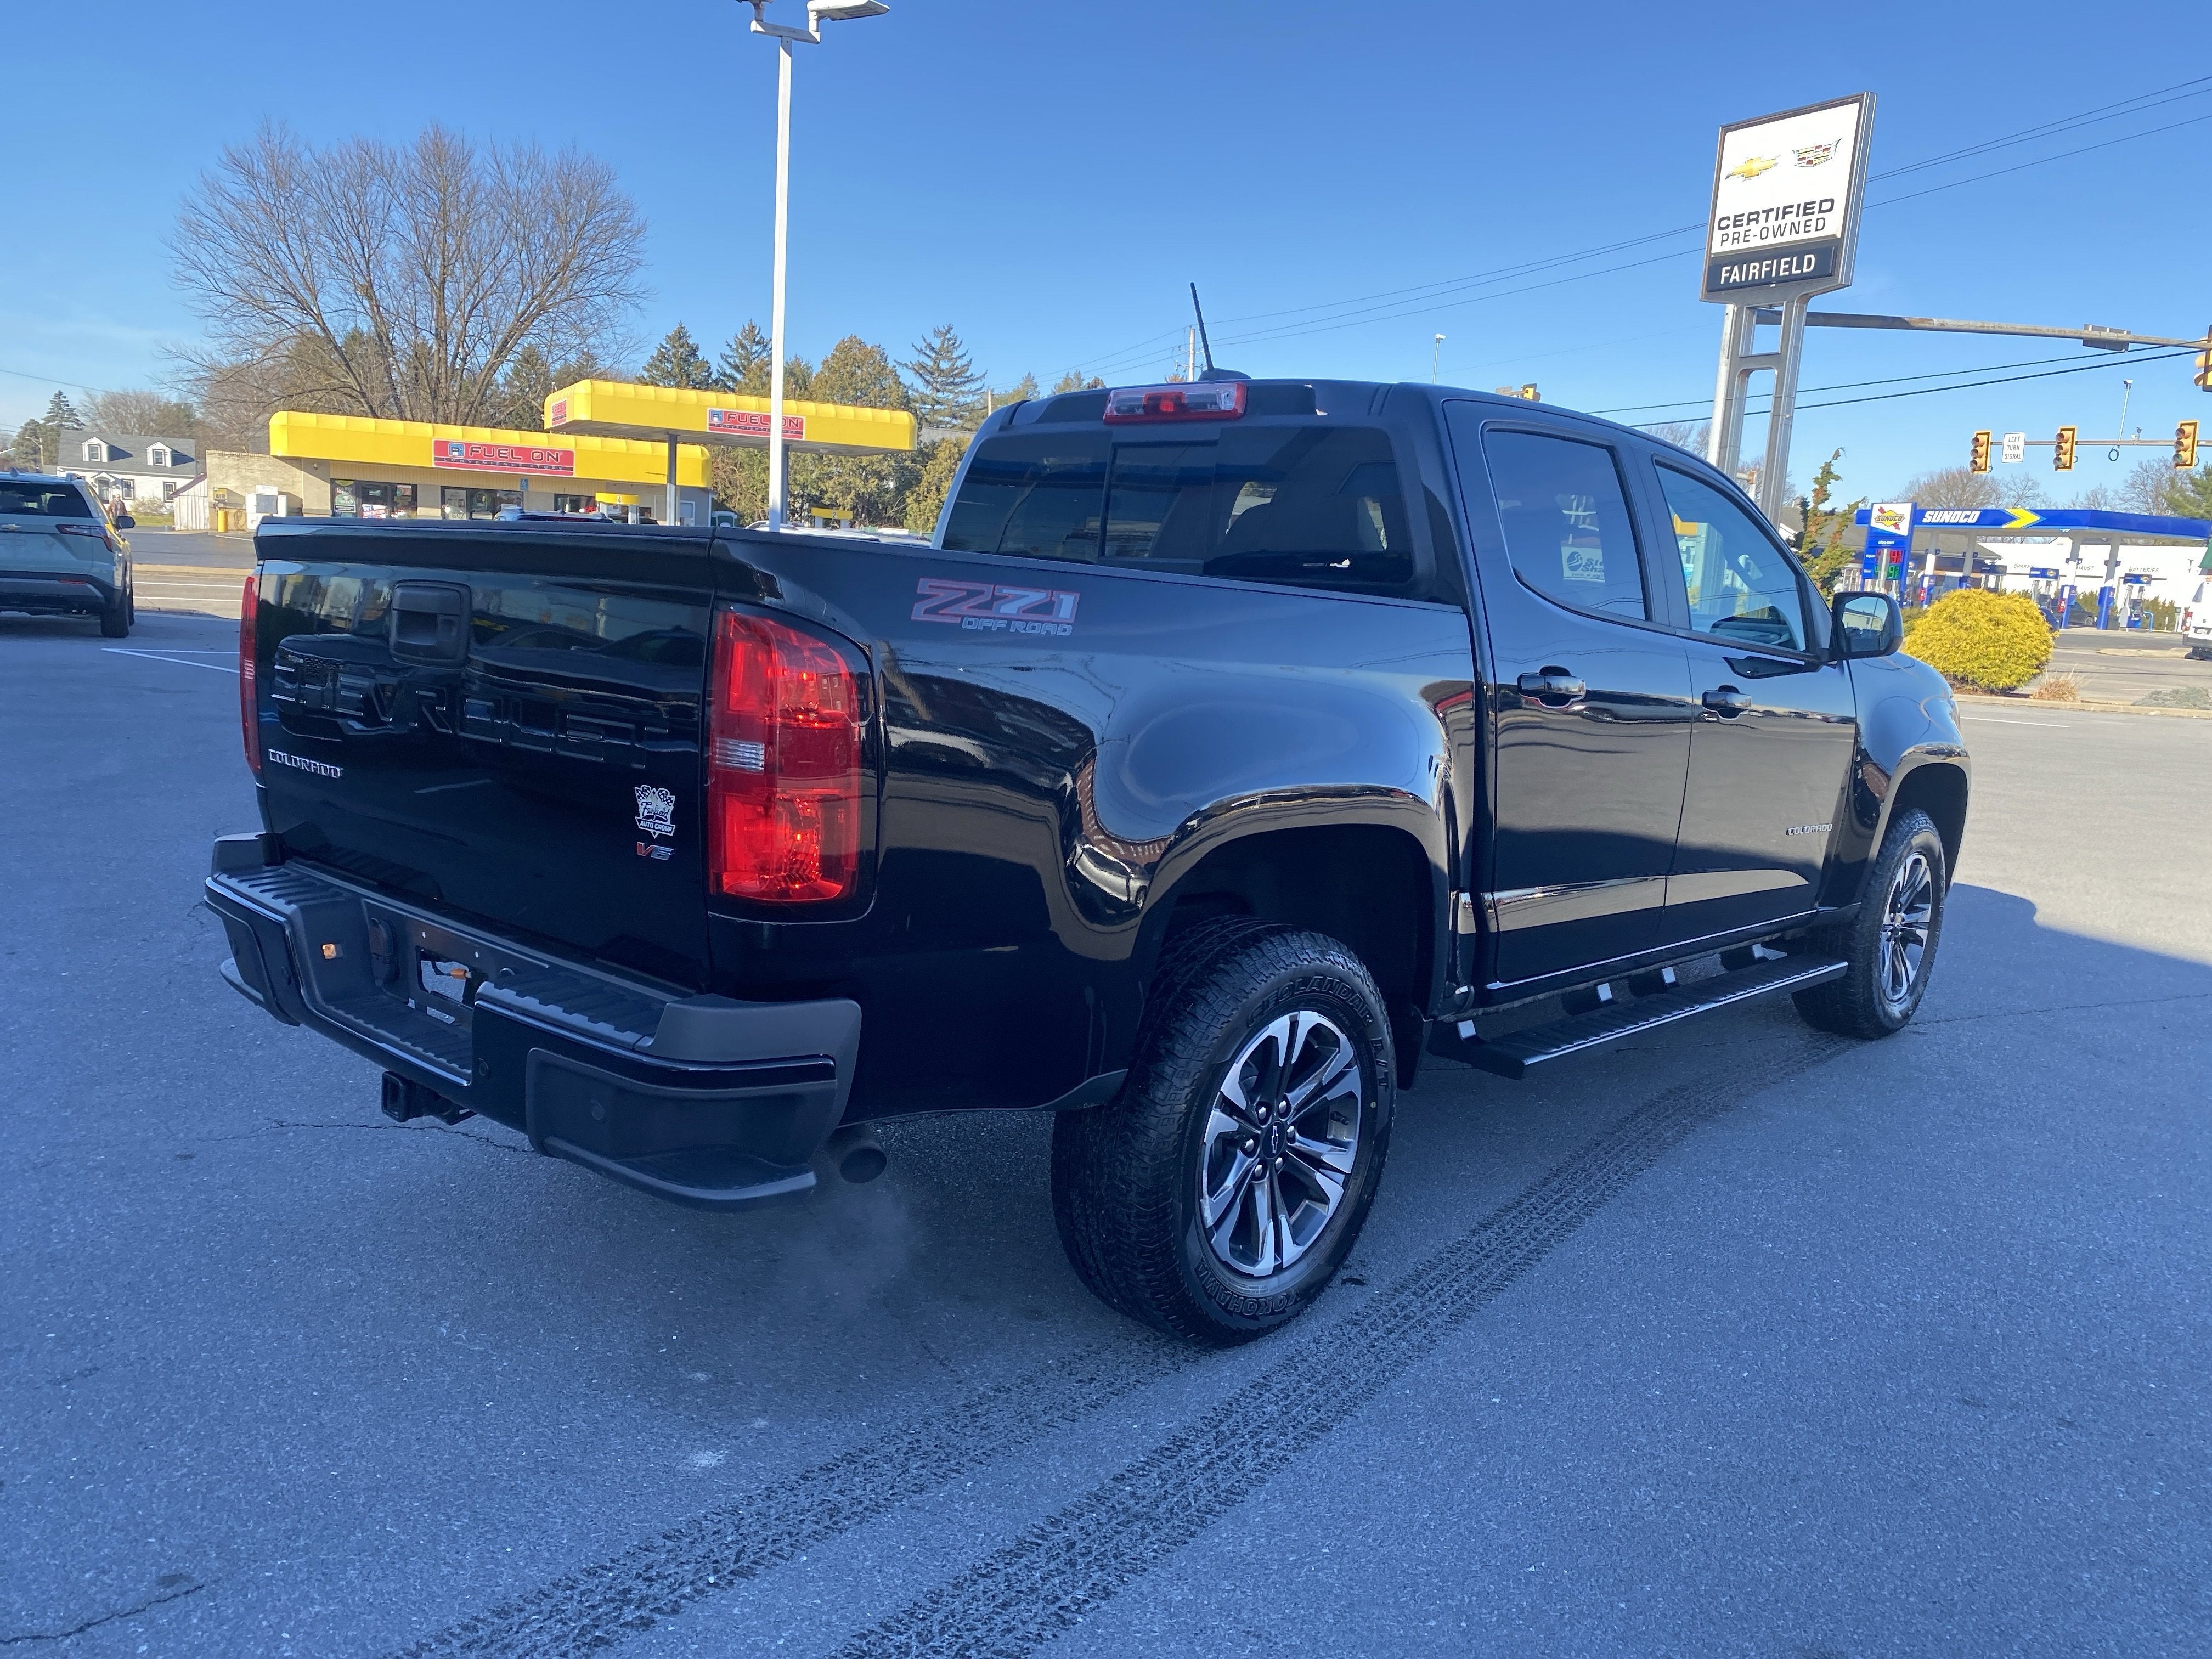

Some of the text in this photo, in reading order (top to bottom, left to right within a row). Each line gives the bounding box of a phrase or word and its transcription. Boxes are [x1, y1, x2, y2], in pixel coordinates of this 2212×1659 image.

[1717, 198, 1835, 230] CERTIFIED
[1720, 217, 1826, 246] PRE-OWNED
[1720, 254, 1816, 285] FAIRFIELD
[727, 413, 770, 426] FUEL
[443, 458, 522, 467] CONVENIENCE
[469, 445, 560, 463] FUEL ON
[1922, 510, 1981, 523] SUNOCO
[910, 577, 1080, 624] Z71
[962, 617, 1073, 636] OFF ROAD
[271, 658, 669, 768] CHEVROLET
[268, 748, 343, 780] COLORADO
[640, 820, 673, 832] AUTO GROUP
[1786, 823, 1833, 836] COLORADO
[636, 841, 675, 861] V6
[1247, 975, 1374, 1027] GEOLANDAR
[1194, 1257, 1302, 1316] YOKOHAMA
